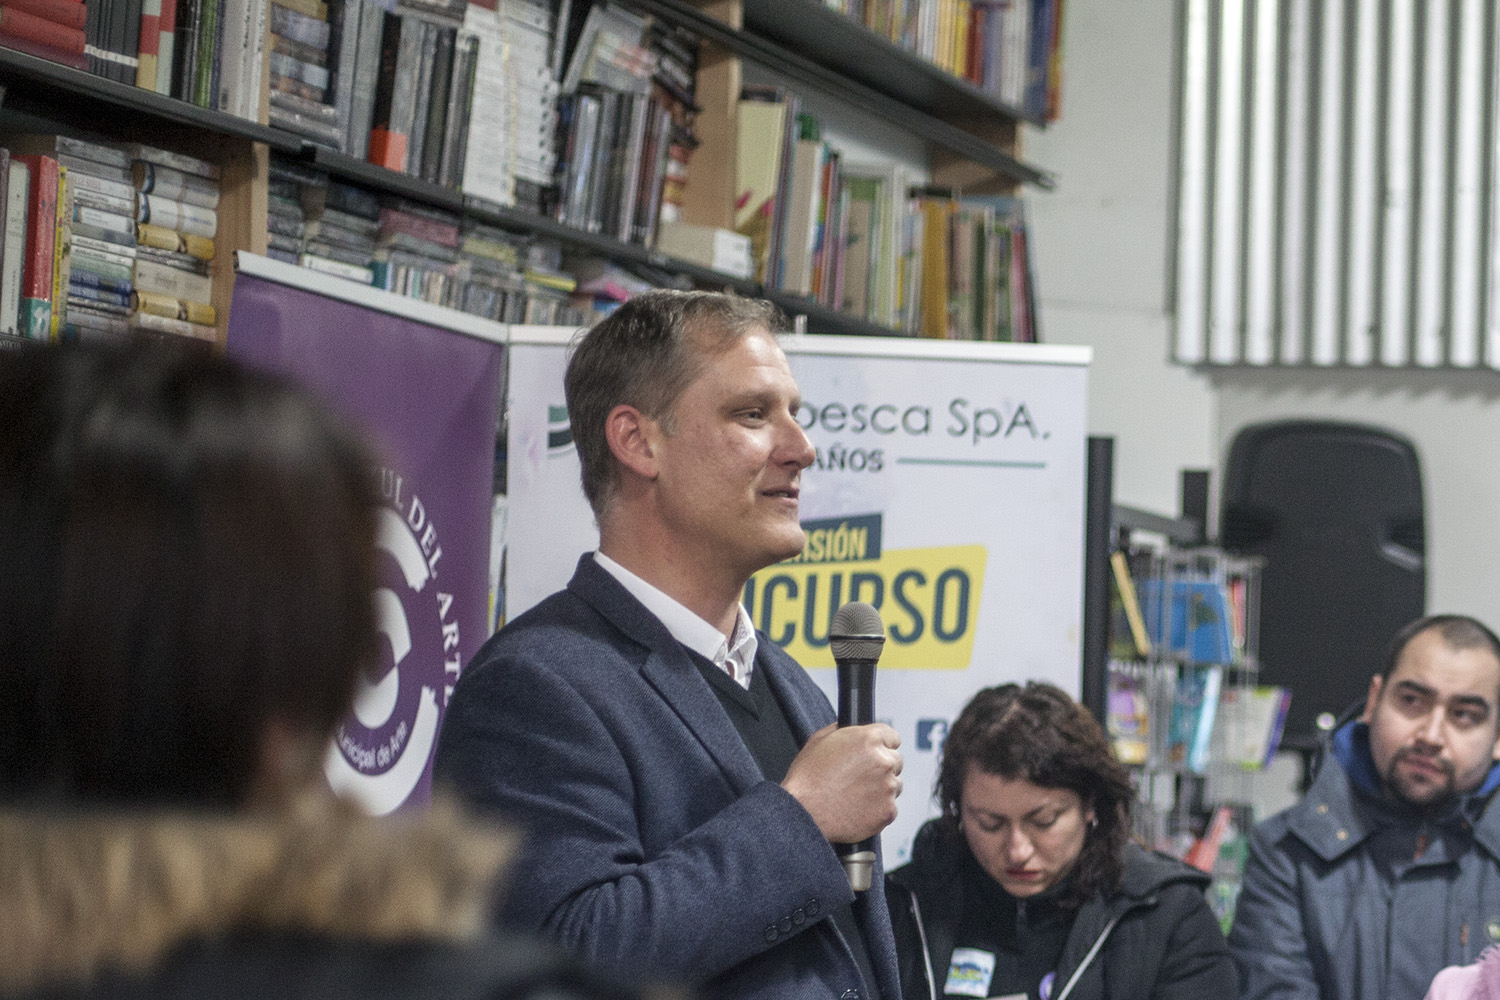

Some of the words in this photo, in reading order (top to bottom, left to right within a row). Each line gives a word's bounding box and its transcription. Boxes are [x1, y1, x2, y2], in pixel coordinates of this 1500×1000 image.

[799, 399, 930, 437] pesca
[947, 397, 1051, 446] SpA.
[407, 495, 443, 580] DEL
